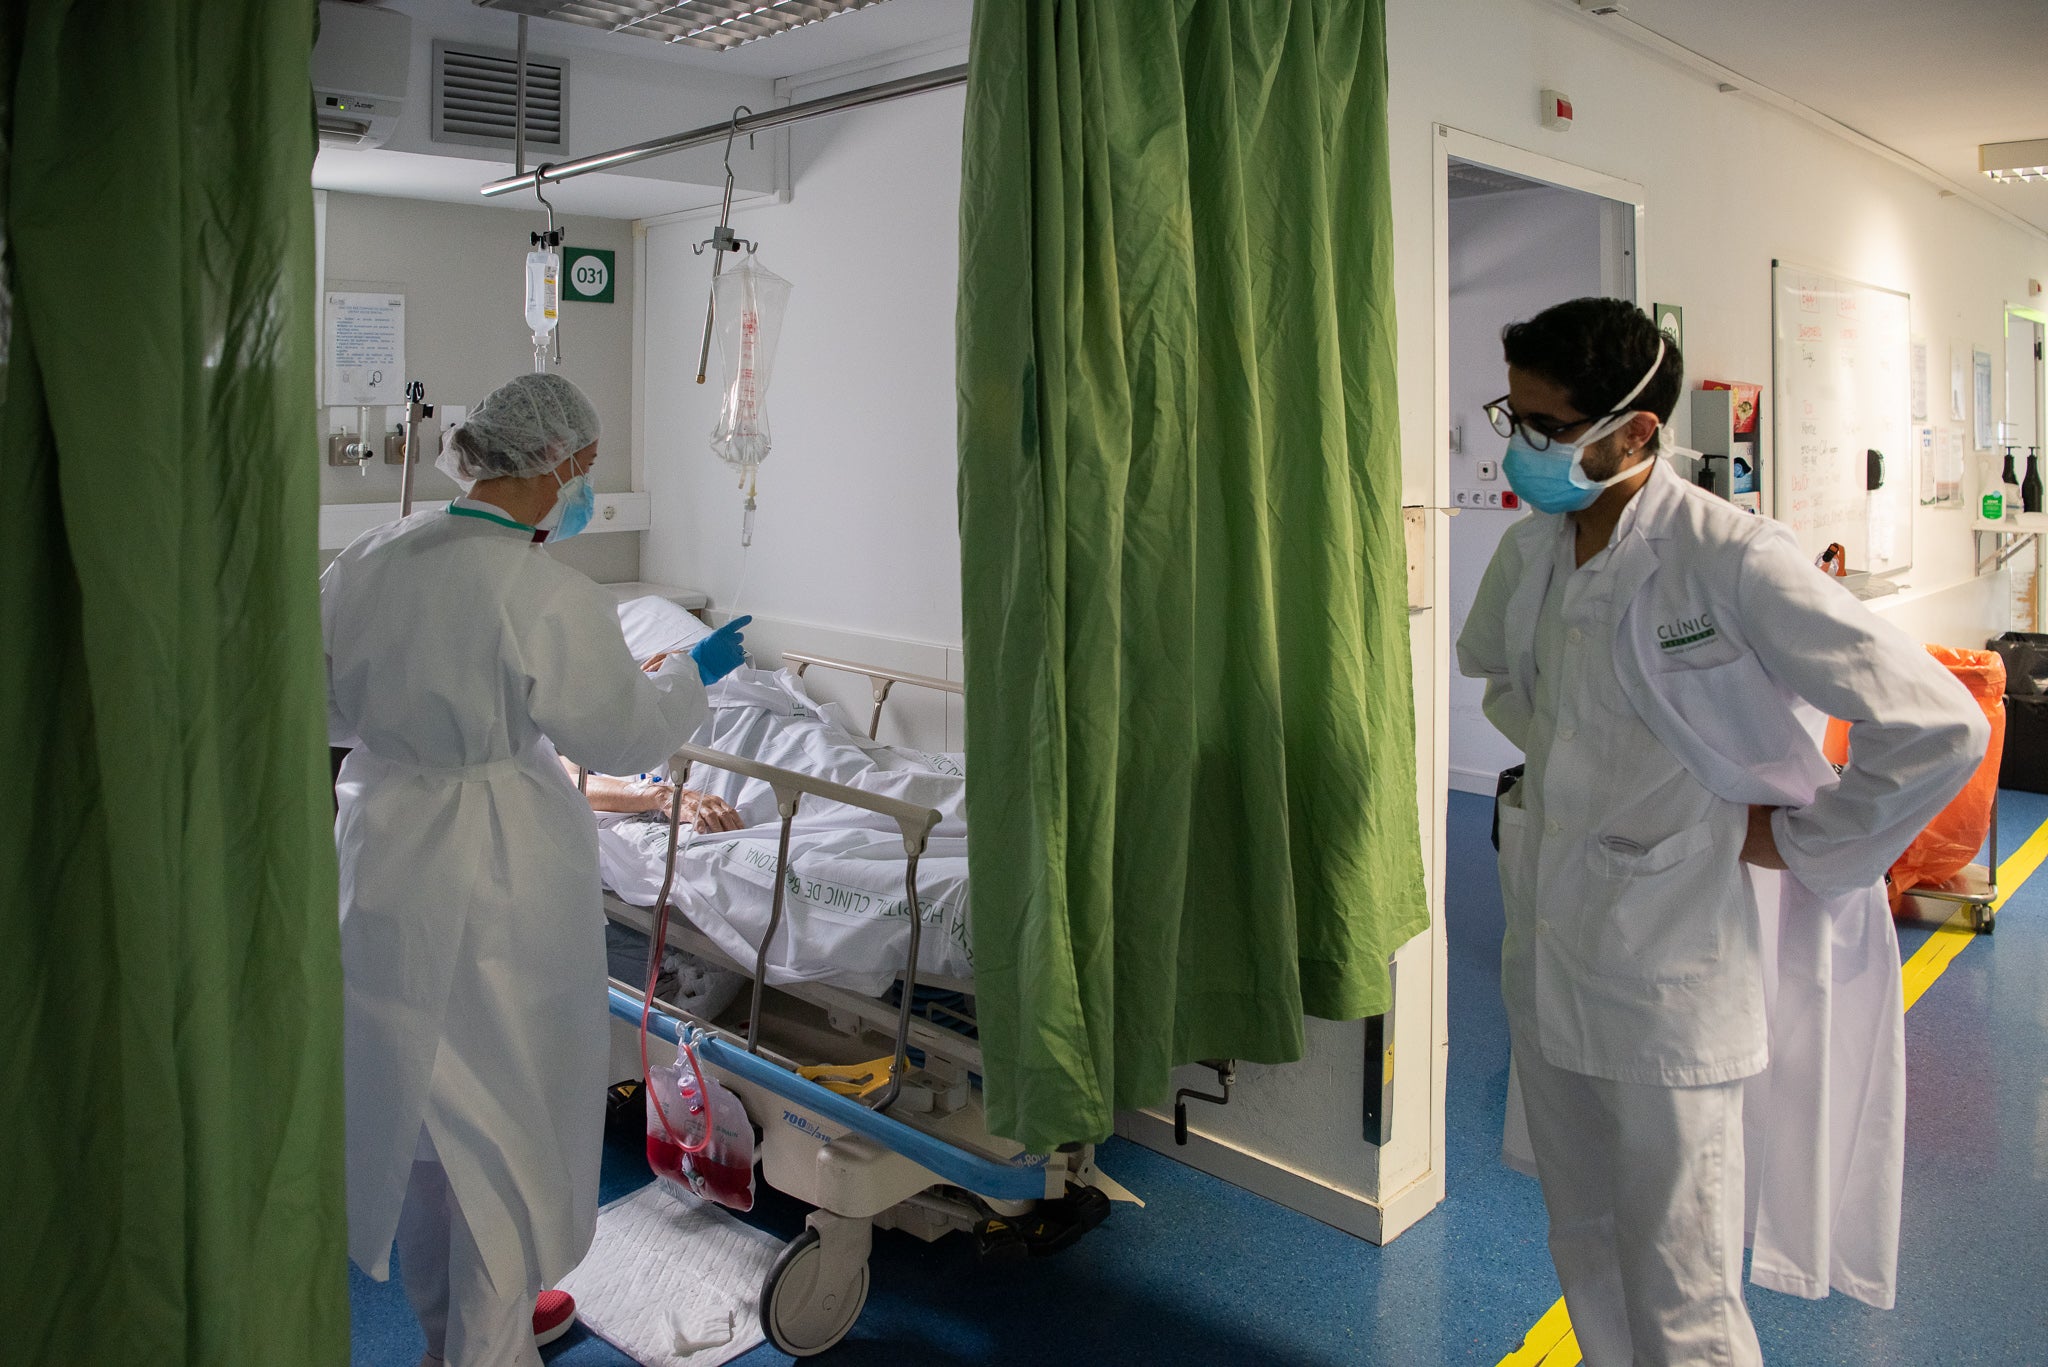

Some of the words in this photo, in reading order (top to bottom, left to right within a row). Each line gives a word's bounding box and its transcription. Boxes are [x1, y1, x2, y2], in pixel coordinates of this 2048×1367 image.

[576, 266, 604, 285] 031
[1656, 613, 1712, 639] CLÍNIC
[744, 847, 801, 895] BALONA
[804, 881, 822, 901] DE
[824, 886, 871, 914] CLÍNIC
